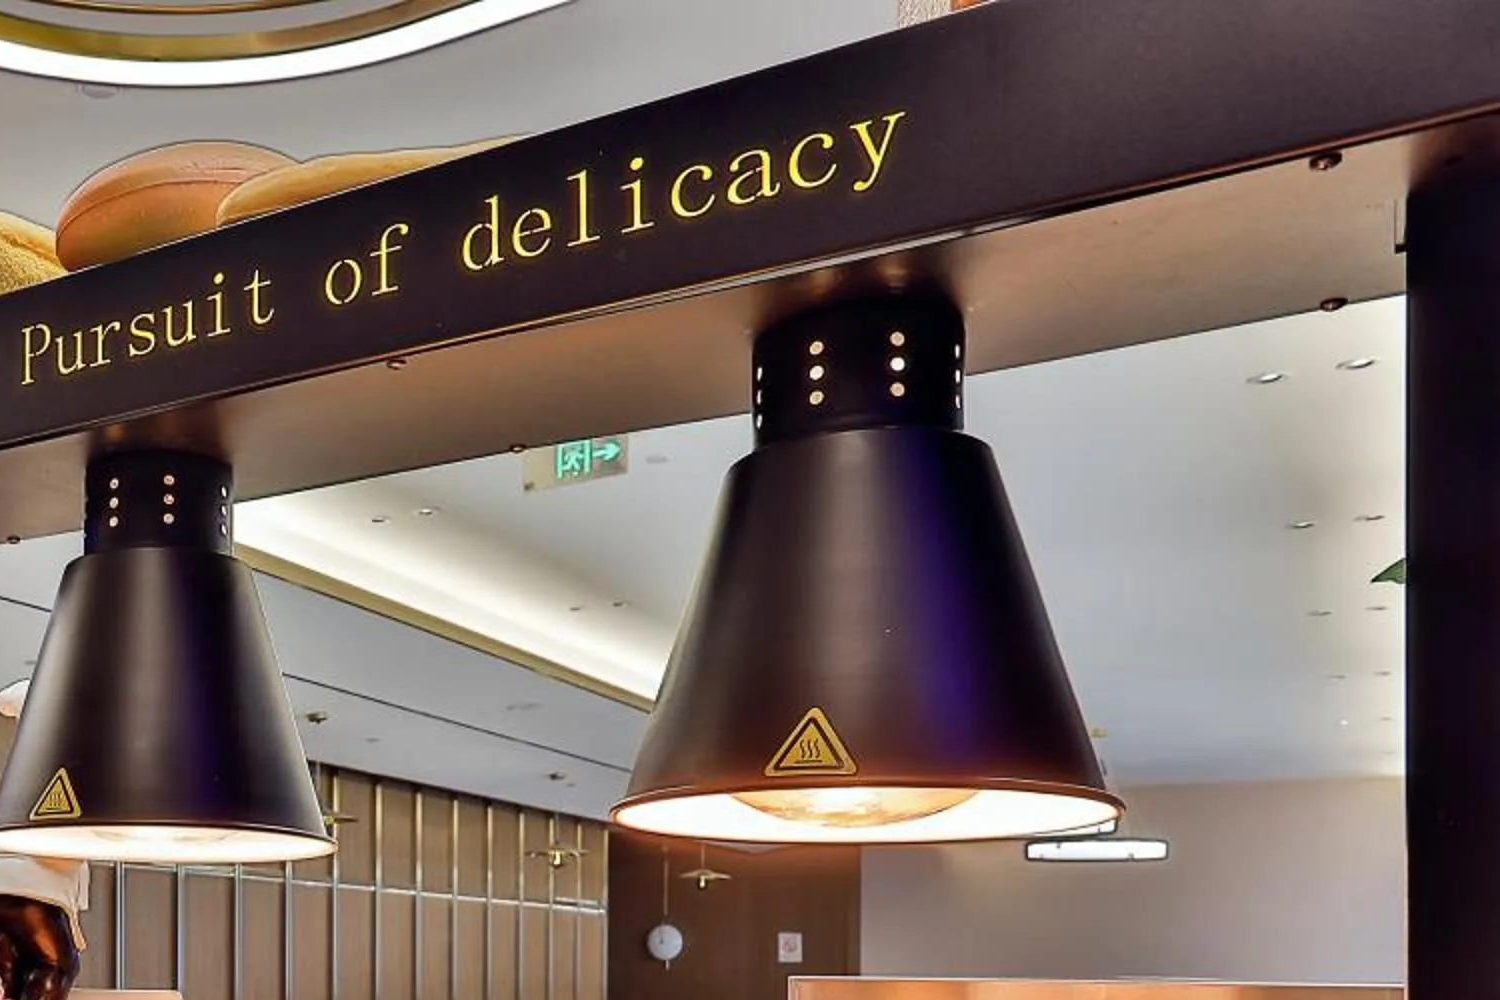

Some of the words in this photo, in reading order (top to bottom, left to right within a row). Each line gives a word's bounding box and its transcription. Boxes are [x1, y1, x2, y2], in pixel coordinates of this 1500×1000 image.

[20, 268, 275, 386] Pursuit
[325, 221, 410, 307] of
[461, 110, 906, 271] delicacy
